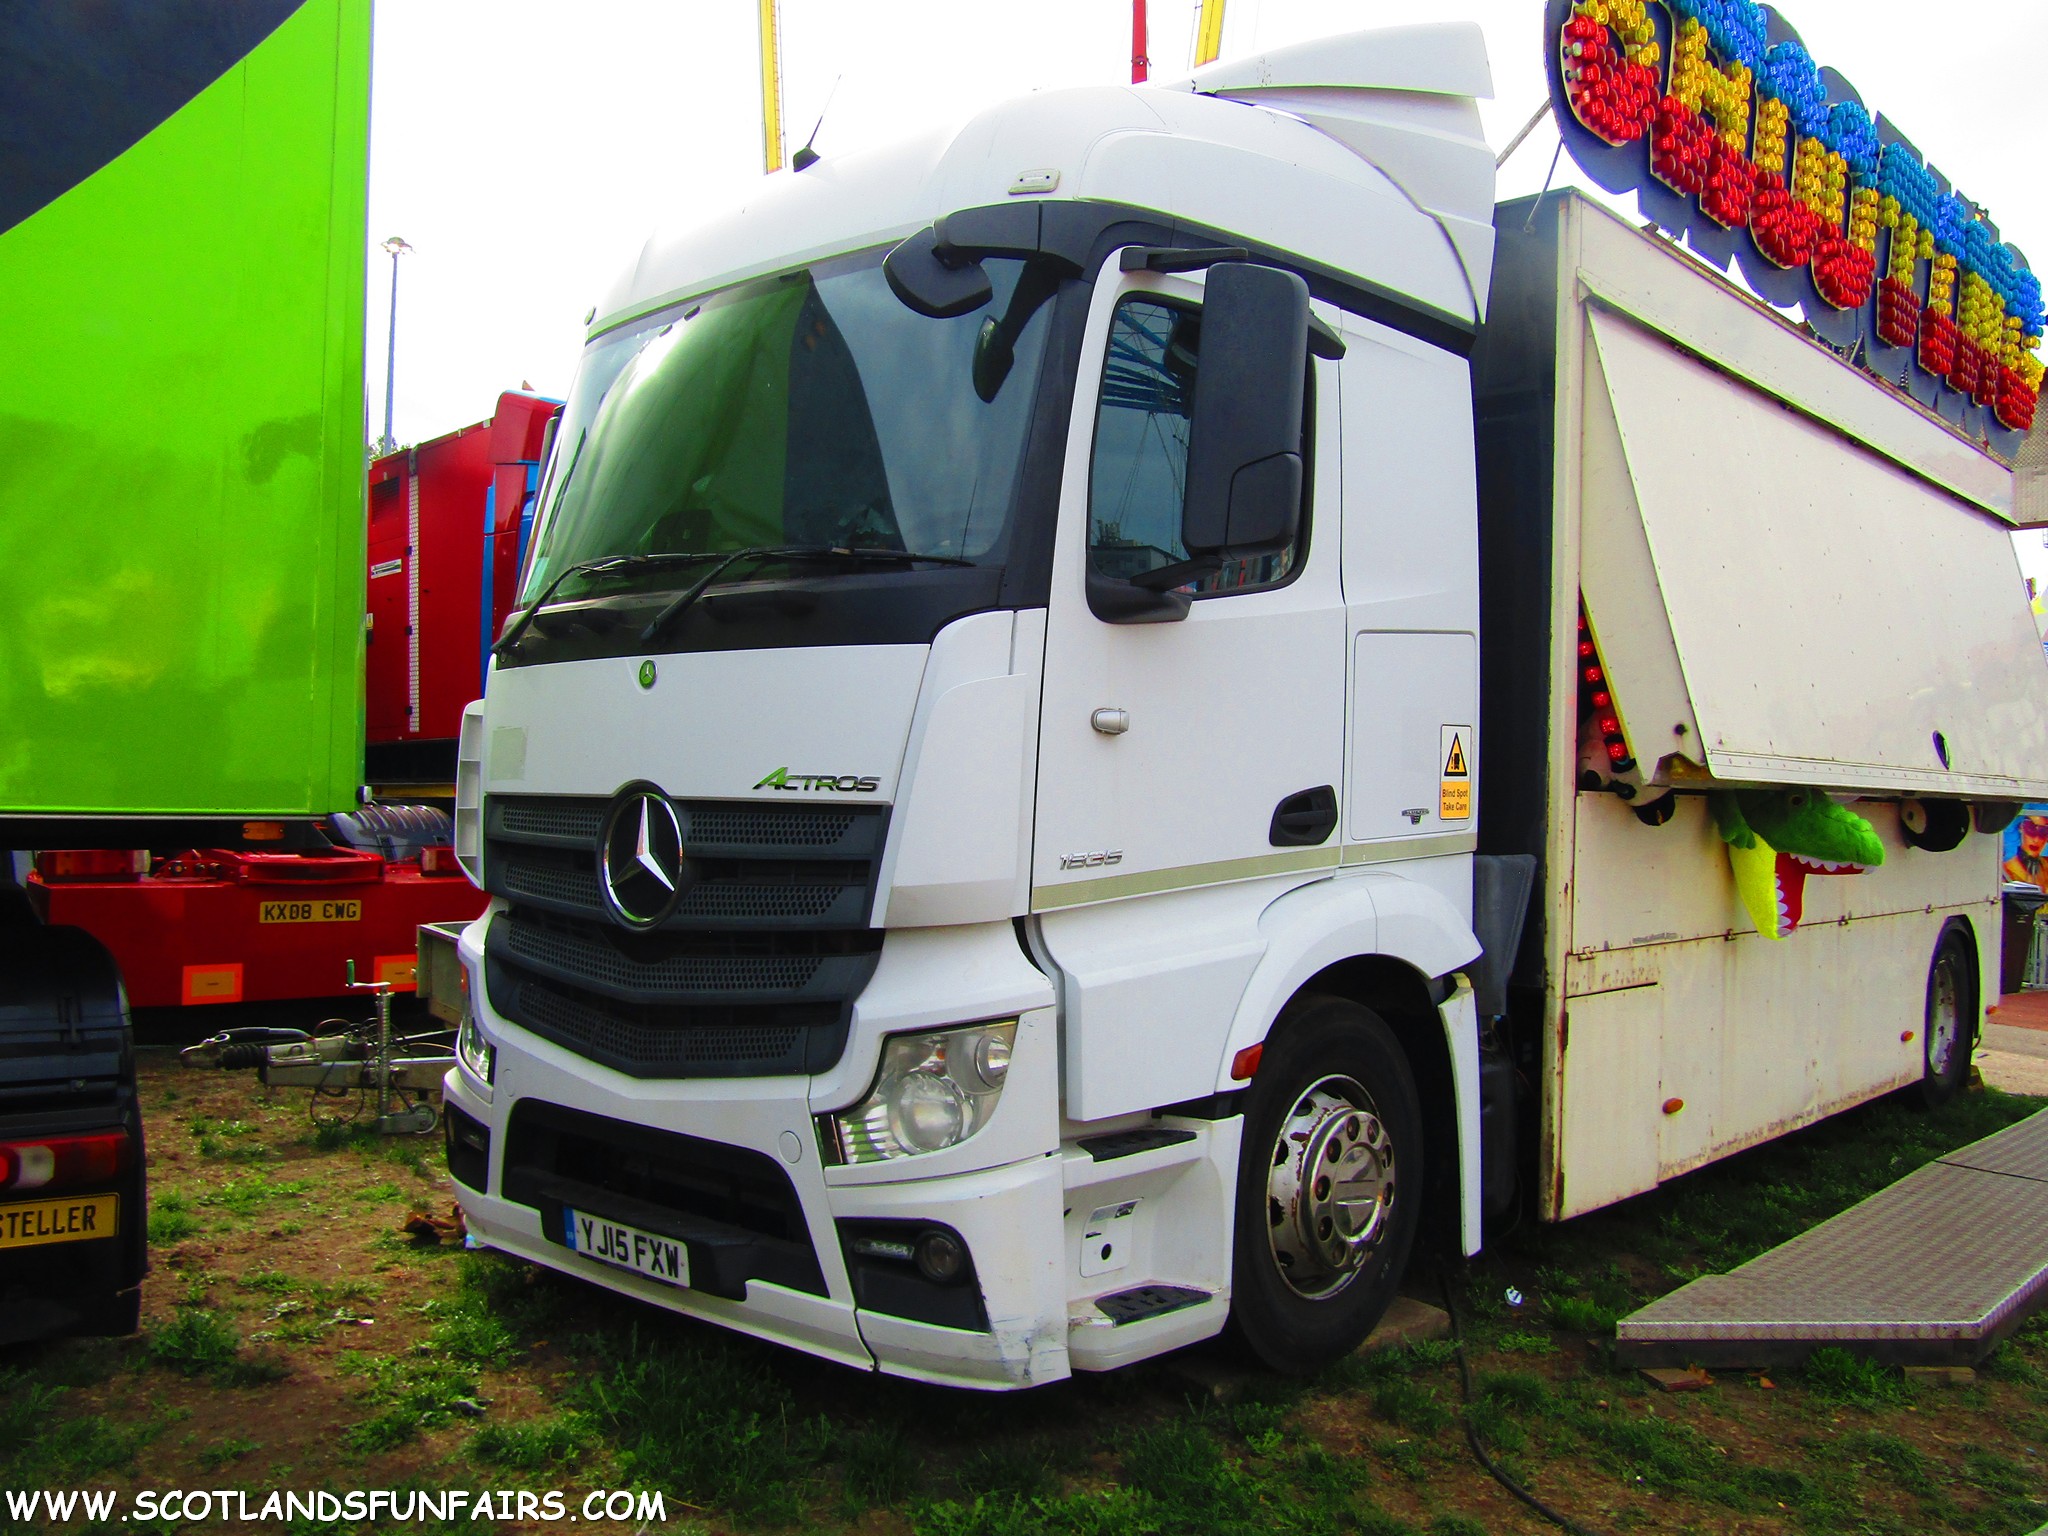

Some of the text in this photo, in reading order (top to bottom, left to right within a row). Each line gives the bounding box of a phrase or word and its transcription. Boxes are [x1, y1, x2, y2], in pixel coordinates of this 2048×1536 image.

[1442, 788, 1468, 799] Blind Spot
[1443, 802, 1467, 811] Take Care
[264, 902, 357, 920] KX08 CWG
[581, 1218, 679, 1278] YJ15 FXW
